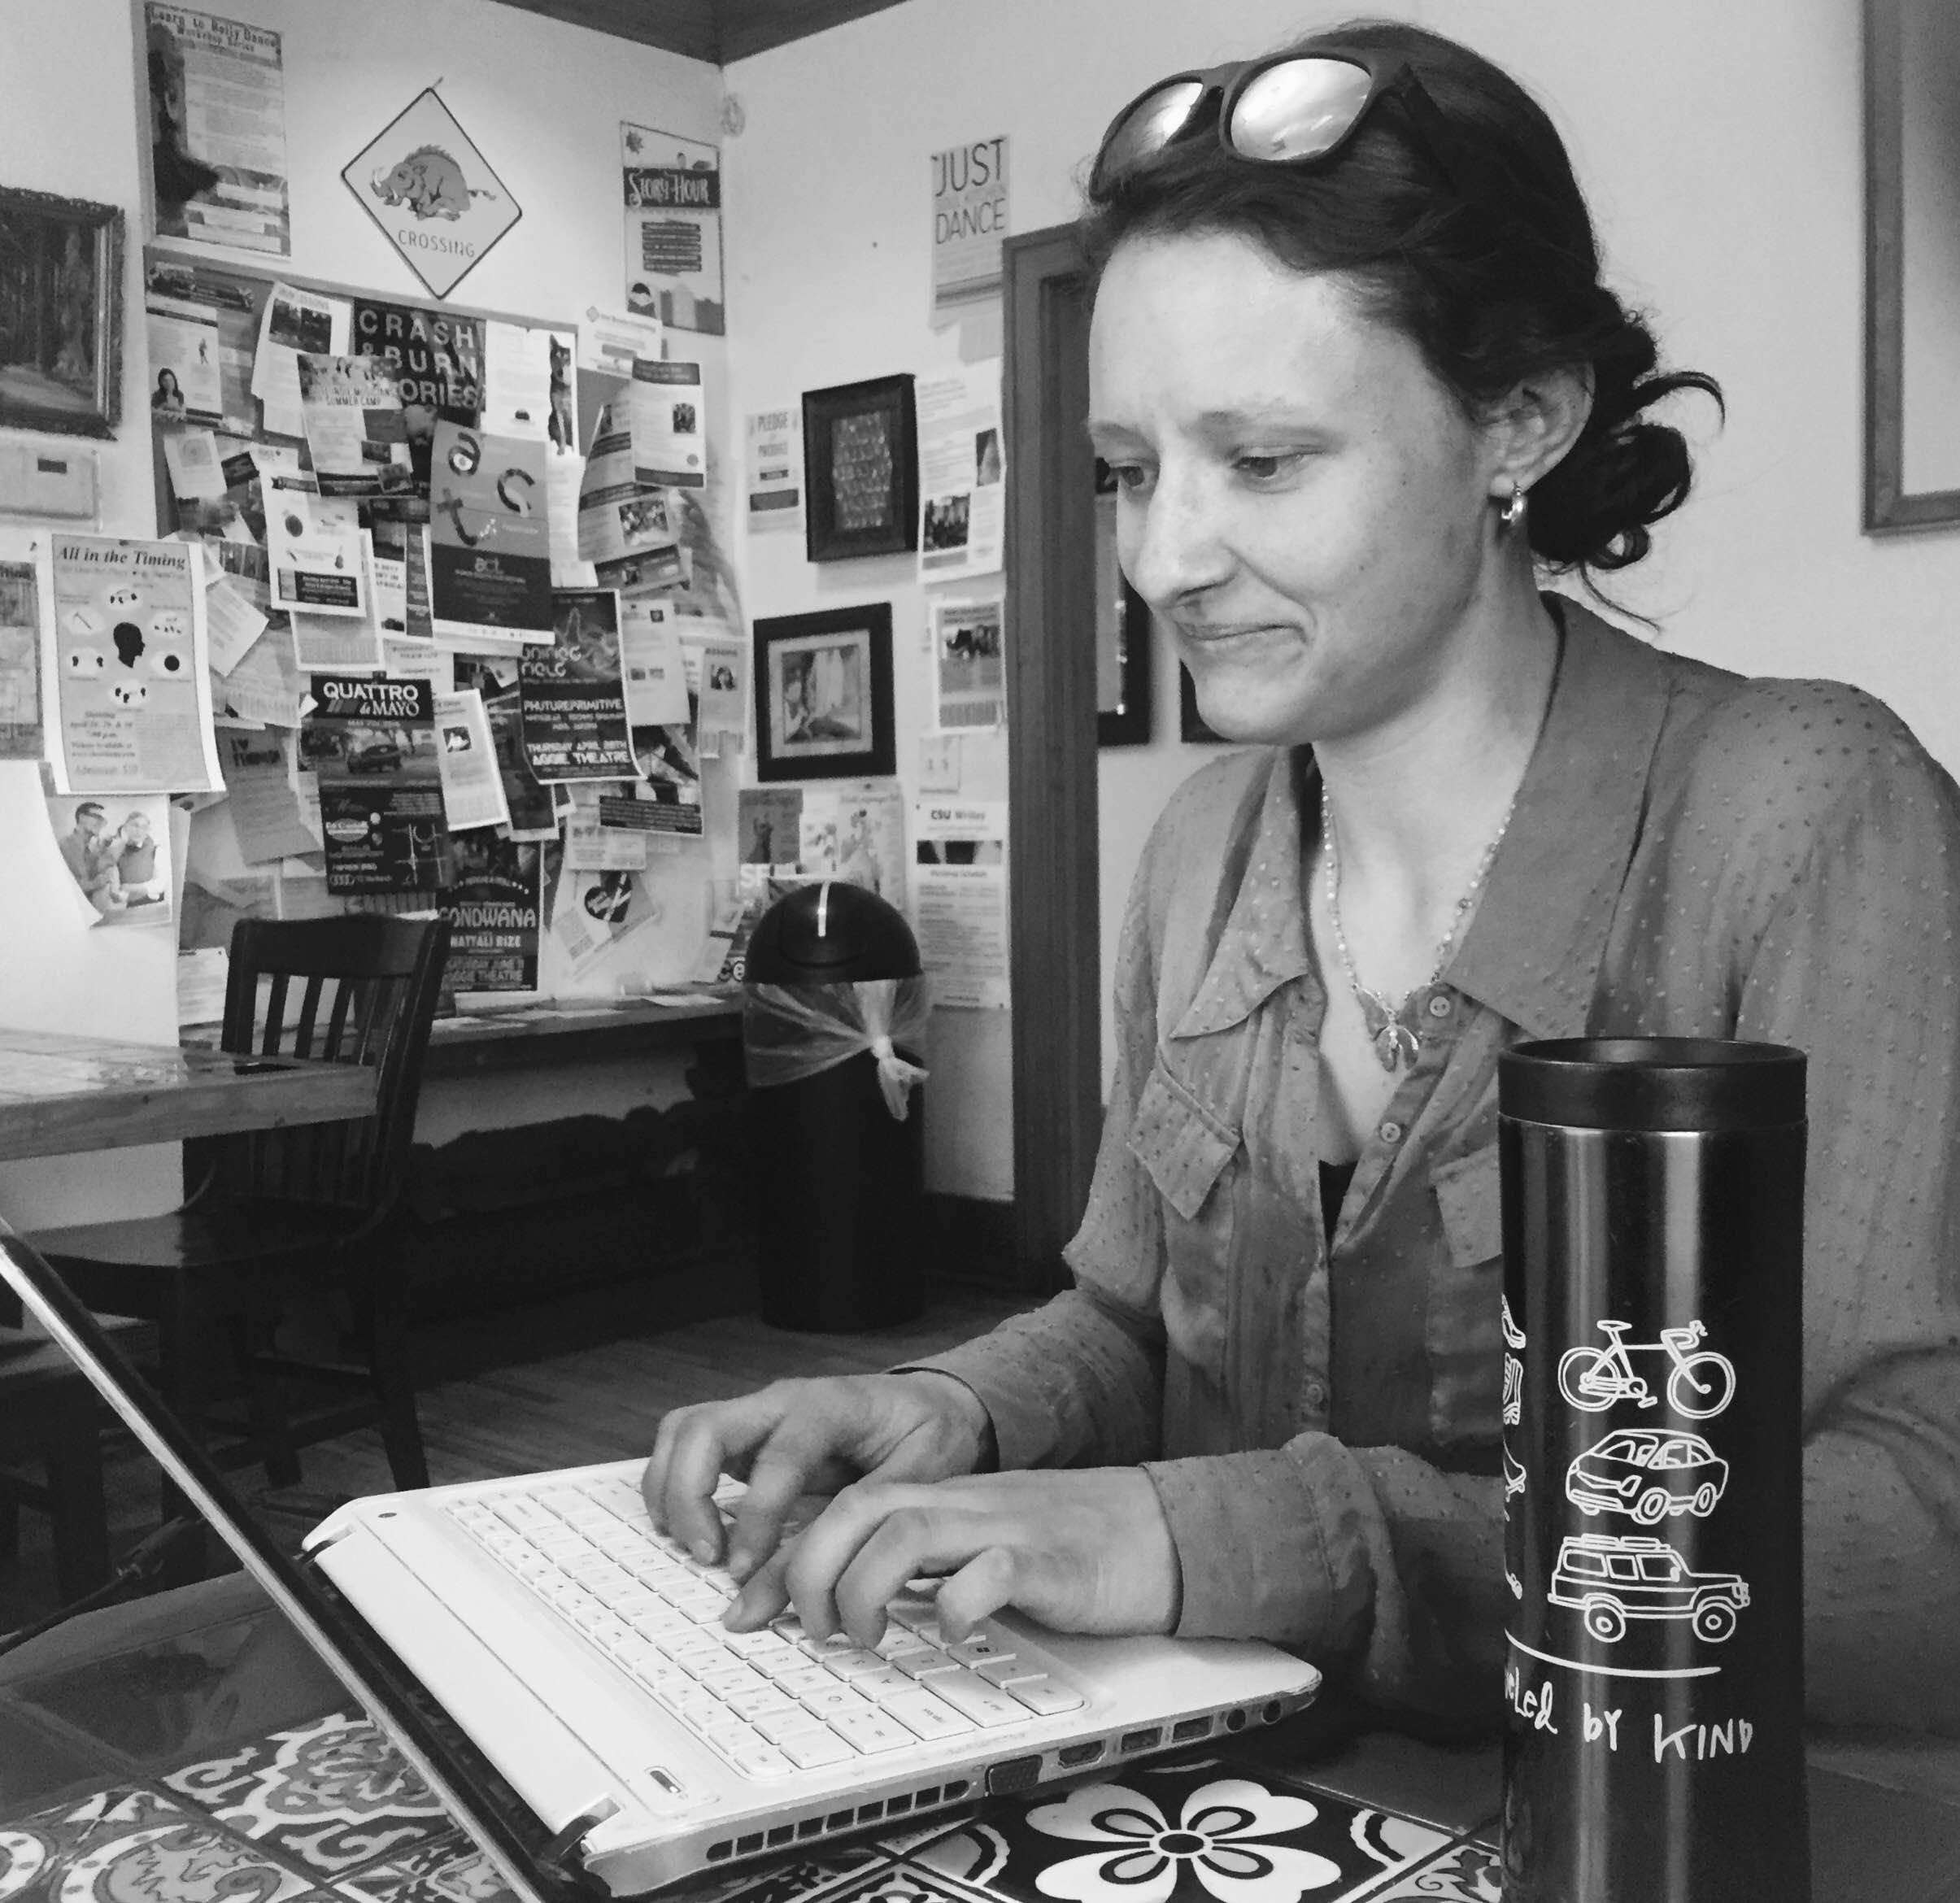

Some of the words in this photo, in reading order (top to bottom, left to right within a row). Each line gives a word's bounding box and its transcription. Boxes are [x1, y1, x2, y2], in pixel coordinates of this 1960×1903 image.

[930, 138, 1004, 197] JUST
[936, 198, 1005, 244] DANCE
[398, 229, 475, 258] CROSSING
[359, 309, 474, 348] CRASH
[385, 345, 478, 380] BURN
[398, 378, 478, 407] ORIES
[58, 547, 81, 561] All
[84, 548, 99, 562] in
[104, 550, 127, 564] the
[133, 551, 186, 570] Timing
[323, 682, 419, 702] QUATTRO
[372, 700, 420, 717] MAYO
[930, 809, 952, 821] CSU
[1654, 1713, 1753, 1763] KIND
